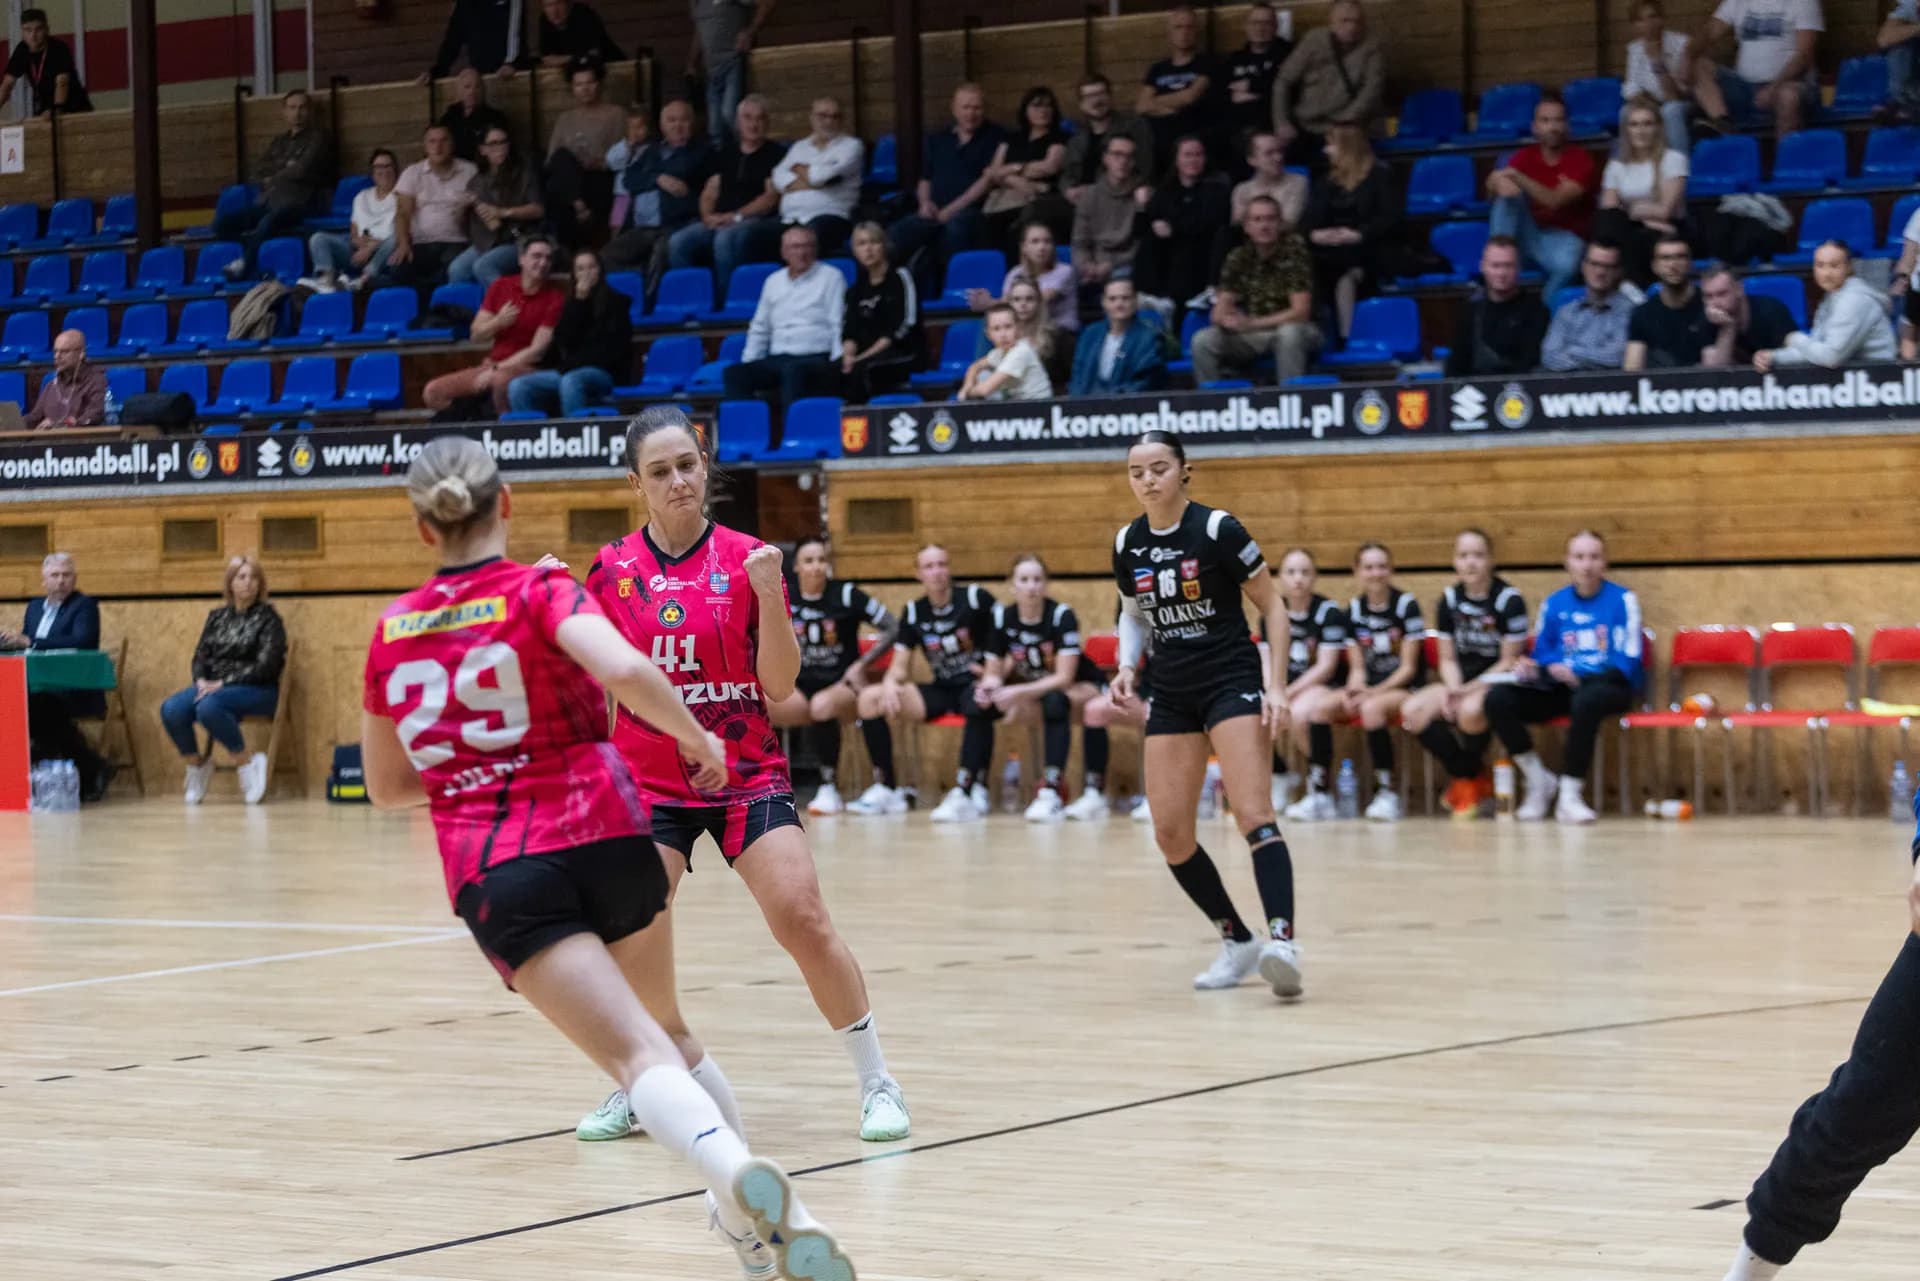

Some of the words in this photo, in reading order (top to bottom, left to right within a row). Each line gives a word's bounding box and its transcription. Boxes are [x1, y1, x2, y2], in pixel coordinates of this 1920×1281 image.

[965, 392, 1344, 442] www.koronahandball.pl
[322, 425, 627, 466] www.kohandball.p
[1158, 568, 1177, 598] 16
[1158, 598, 1217, 626] OLKUSZ
[651, 634, 700, 673] 41
[386, 641, 532, 771] 29
[673, 682, 759, 705] ZUKI
